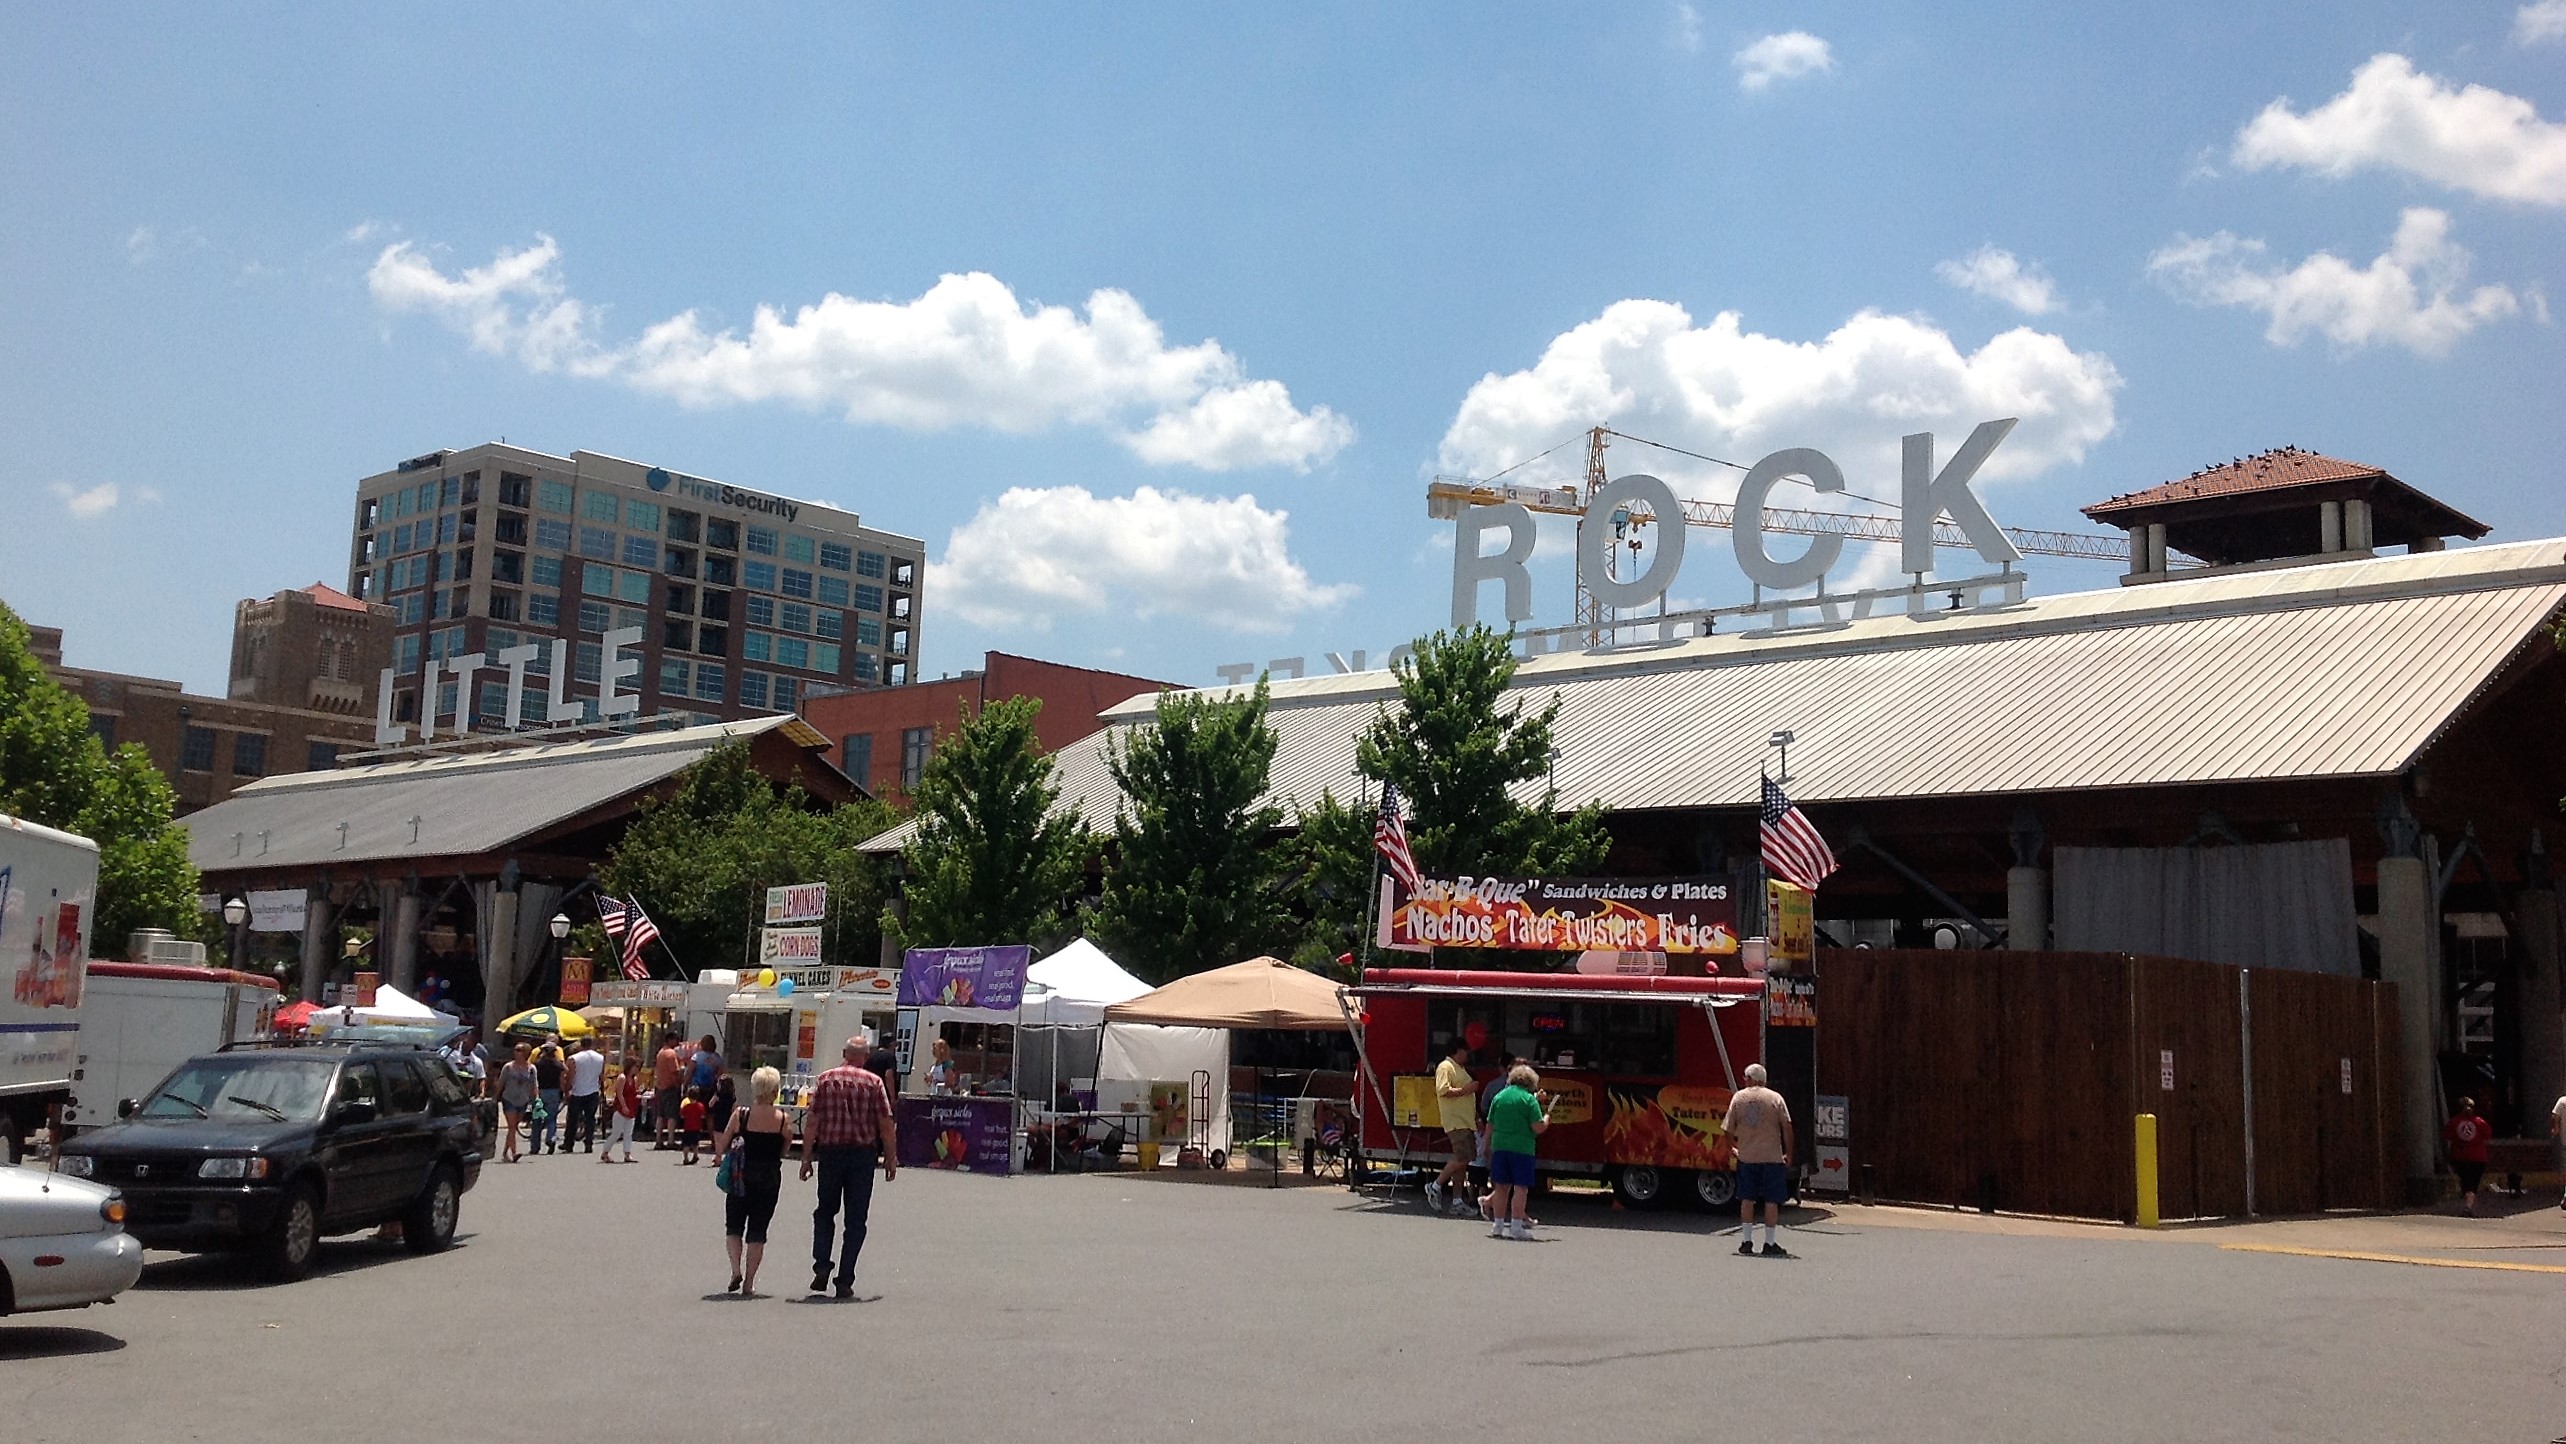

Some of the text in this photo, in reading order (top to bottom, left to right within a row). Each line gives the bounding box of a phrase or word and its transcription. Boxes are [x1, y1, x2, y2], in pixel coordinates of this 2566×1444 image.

[1450, 417, 2023, 632] ROCK
[375, 626, 642, 744] LITTLE
[783, 886, 825, 918] LEMONADE
[1543, 884, 1648, 899] Sandwiches
[1652, 884, 1668, 899] &
[1671, 883, 1728, 900] Plates
[1407, 909, 1728, 949] Nachos Tater Twisters Fries
[780, 935, 800, 957] CORN
[801, 935, 819, 957] DOGS
[808, 971, 831, 987] CAKES
[1672, 1106, 1706, 1119] Tater
